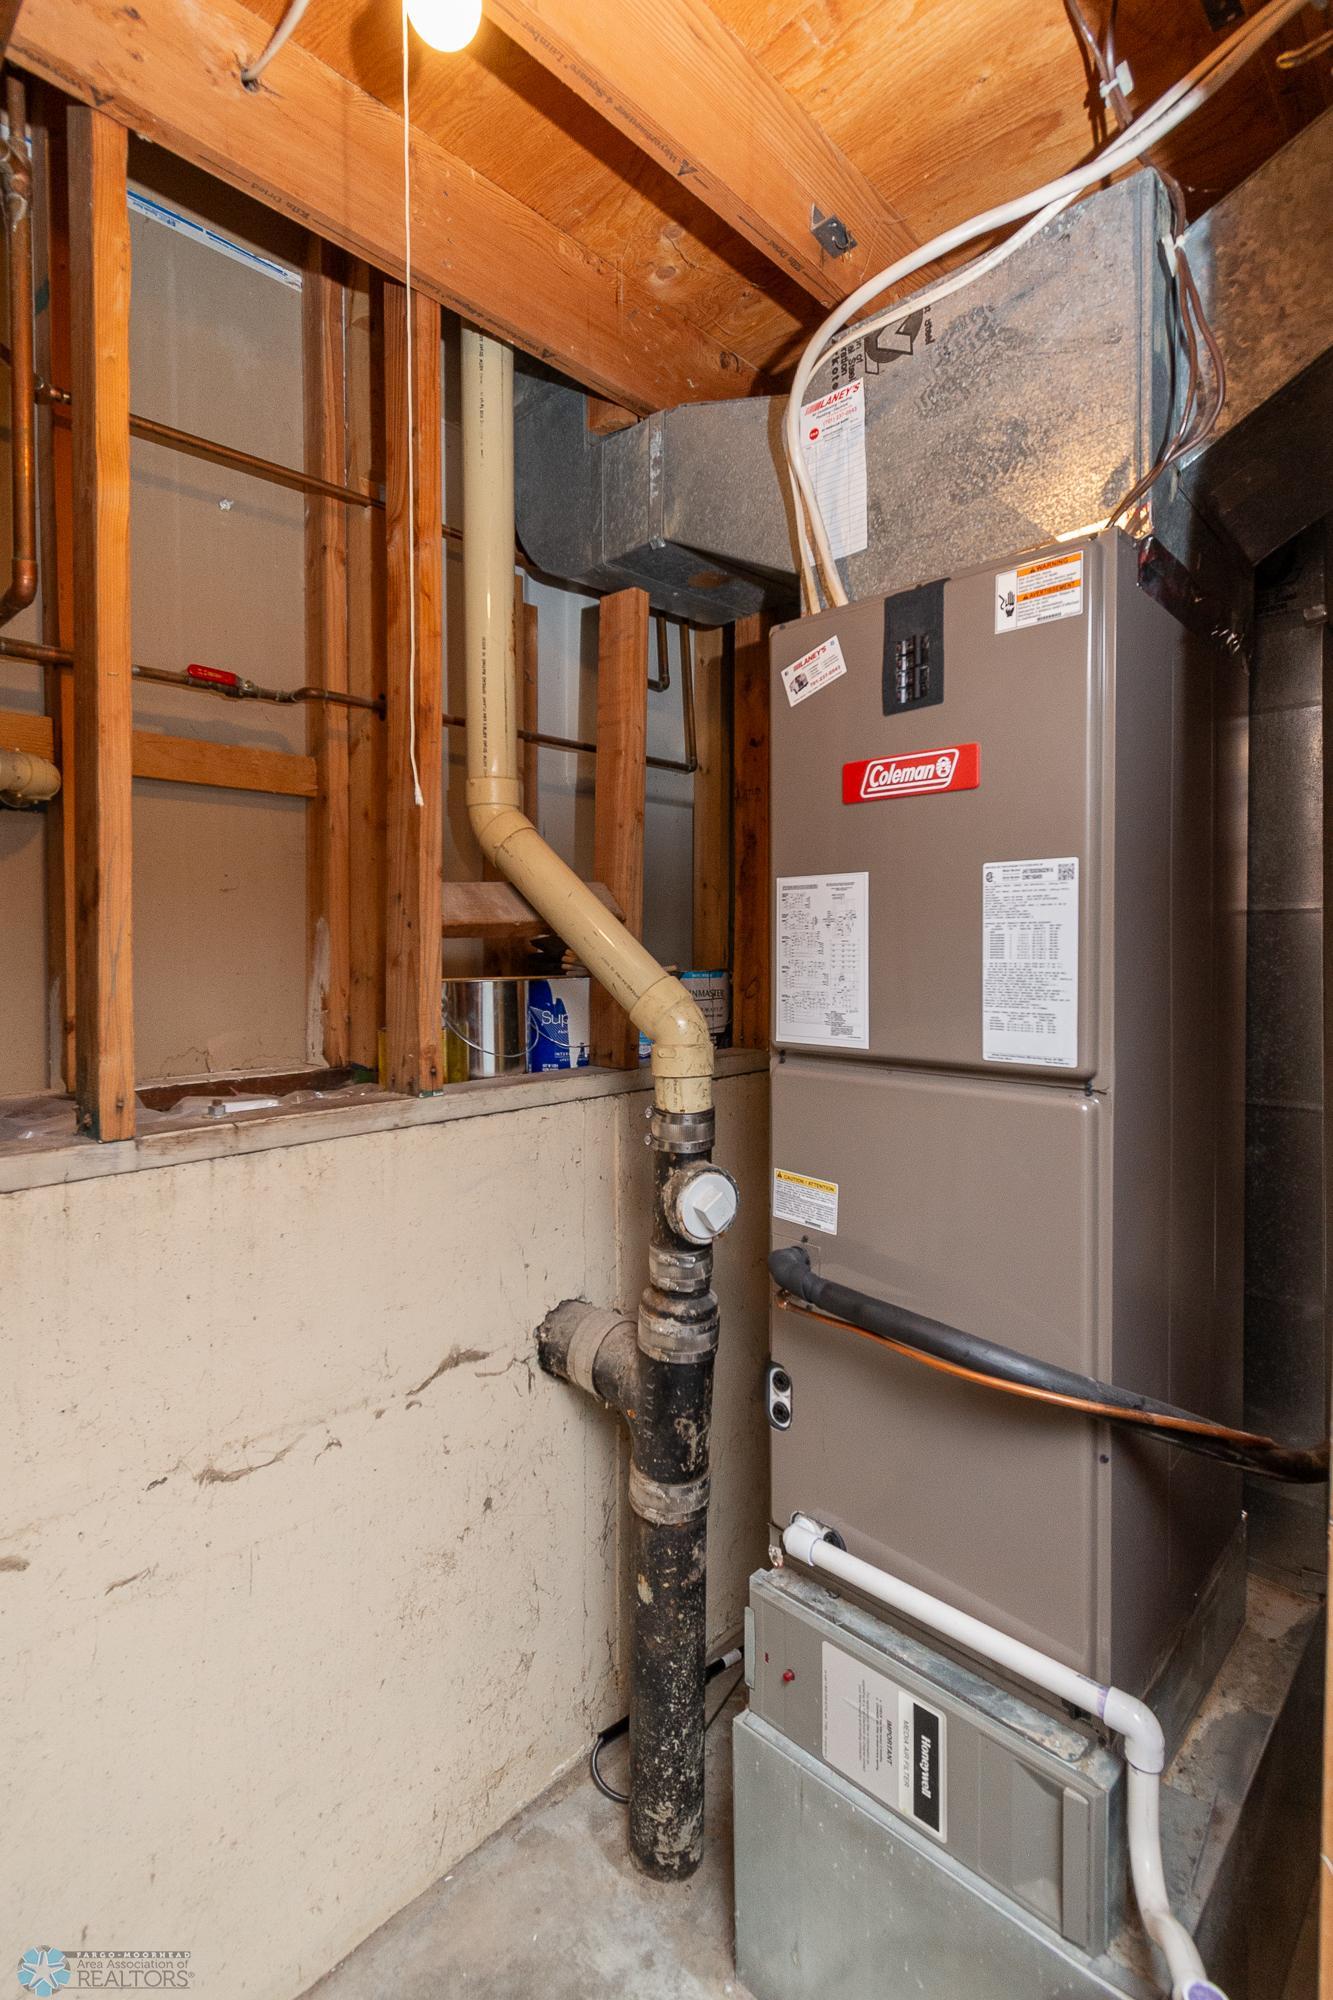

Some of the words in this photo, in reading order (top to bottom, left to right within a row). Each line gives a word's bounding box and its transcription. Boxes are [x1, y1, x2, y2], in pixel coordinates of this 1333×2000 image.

[831, 353, 840, 391] kote
[841, 347, 849, 376] ration
[1036, 556, 1070, 570] WARNING
[869, 763, 936, 787] Coleman
[541, 1010, 568, 1028] Sup
[885, 1720, 893, 1766] IMPORTANT
[902, 1720, 910, 1745] MEDIA
[902, 1746, 910, 1760] AIR
[902, 1761, 910, 1789] FILTER
[919, 1734, 932, 1800] Honeywell
